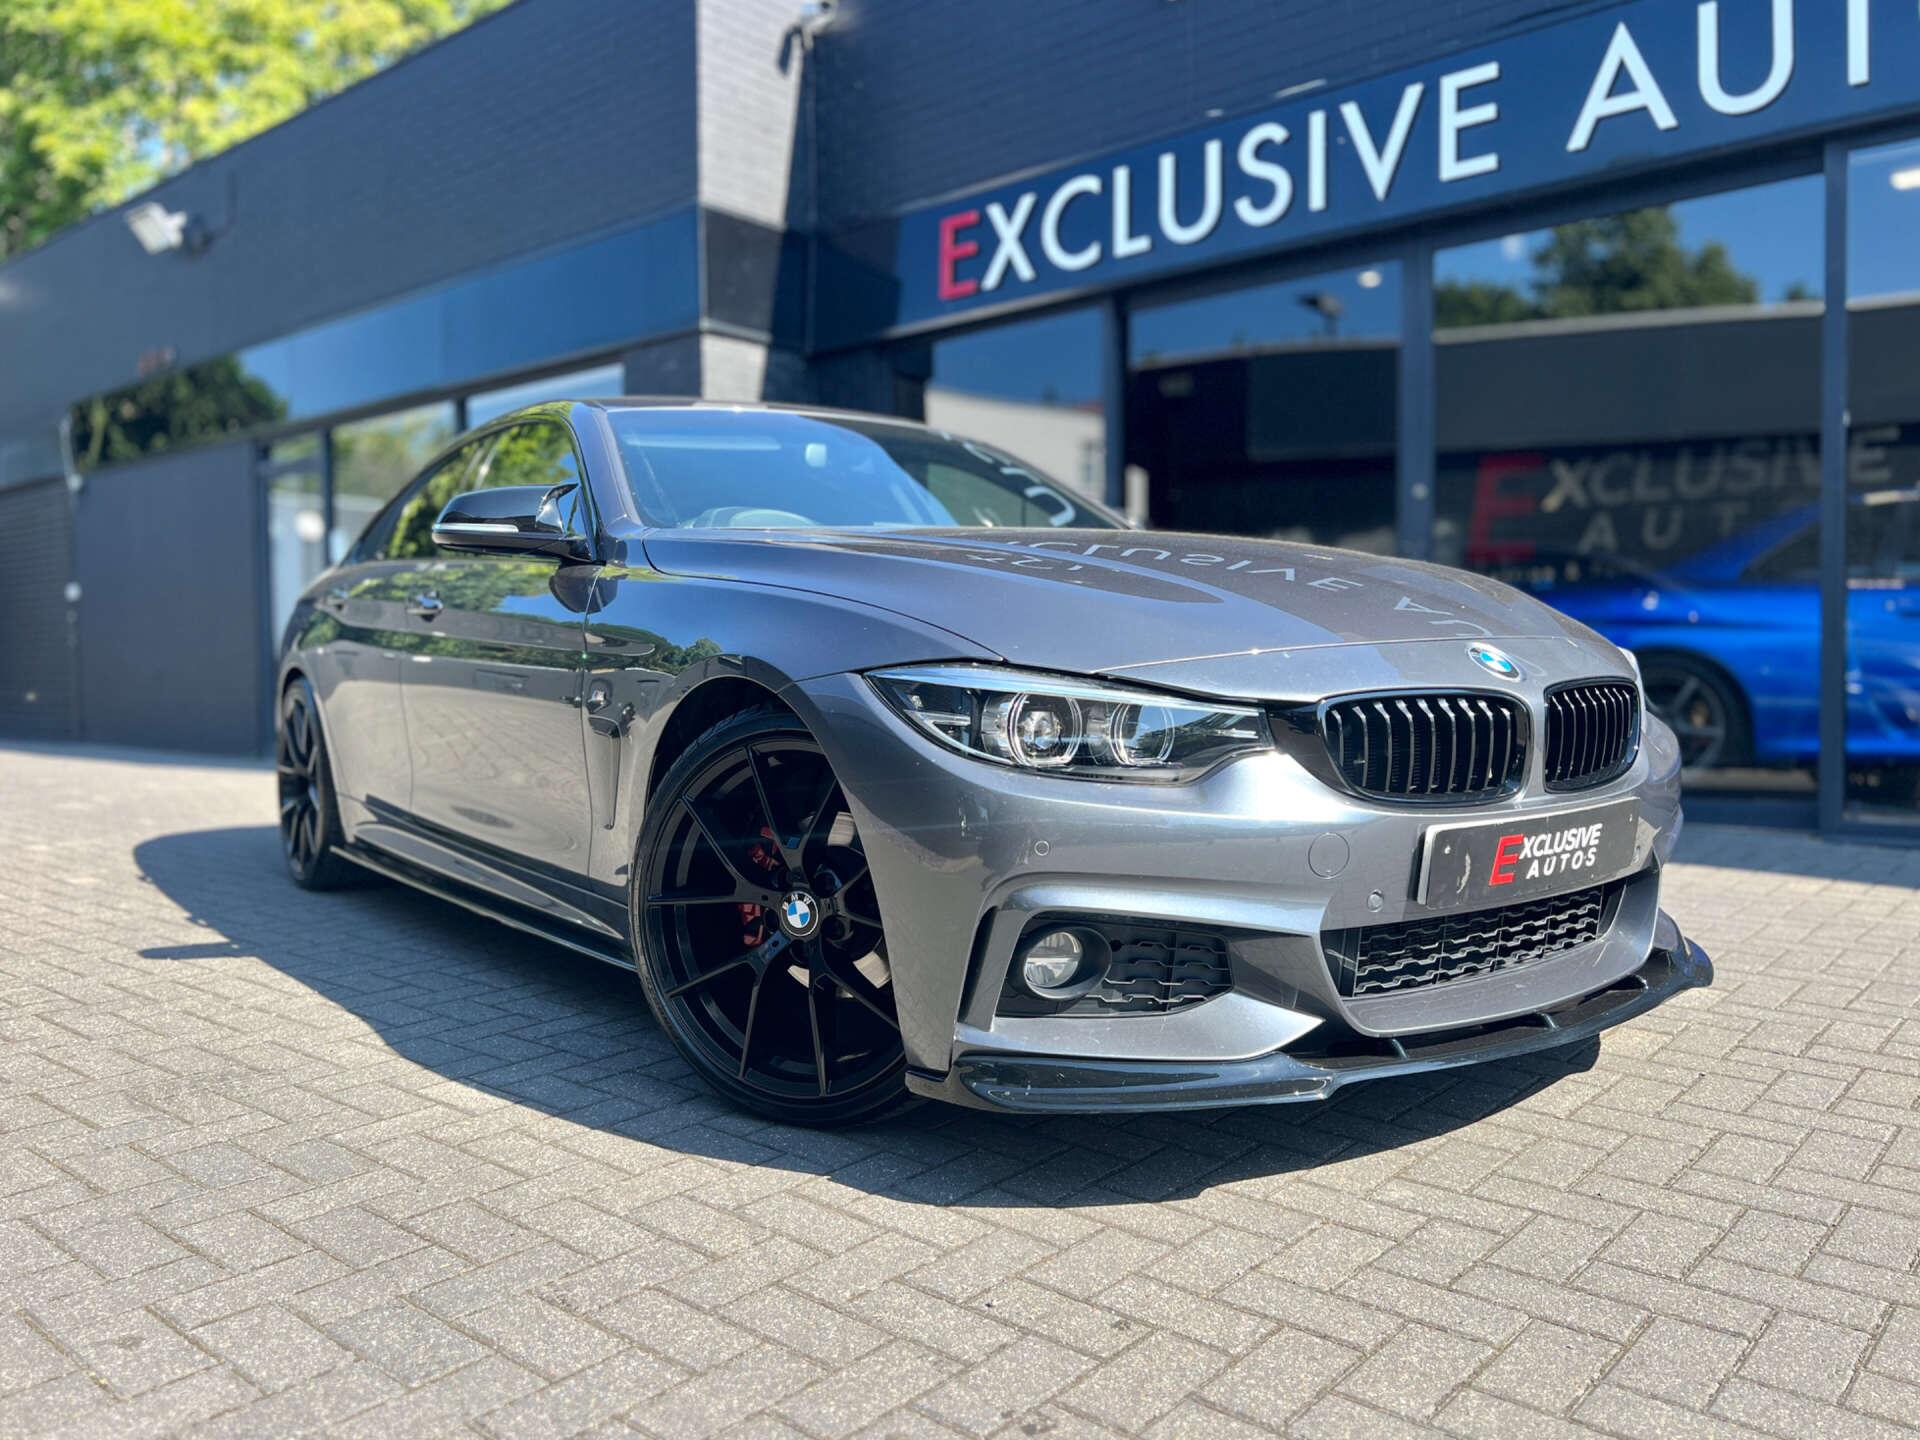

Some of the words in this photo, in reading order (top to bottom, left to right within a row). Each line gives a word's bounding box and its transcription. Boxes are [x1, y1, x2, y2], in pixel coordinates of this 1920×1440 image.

[938, 61, 1500, 299] EXCLUSIVE
[1489, 823, 1602, 886] EXCLUSIVE
[1526, 848, 1596, 880] AUTOS
